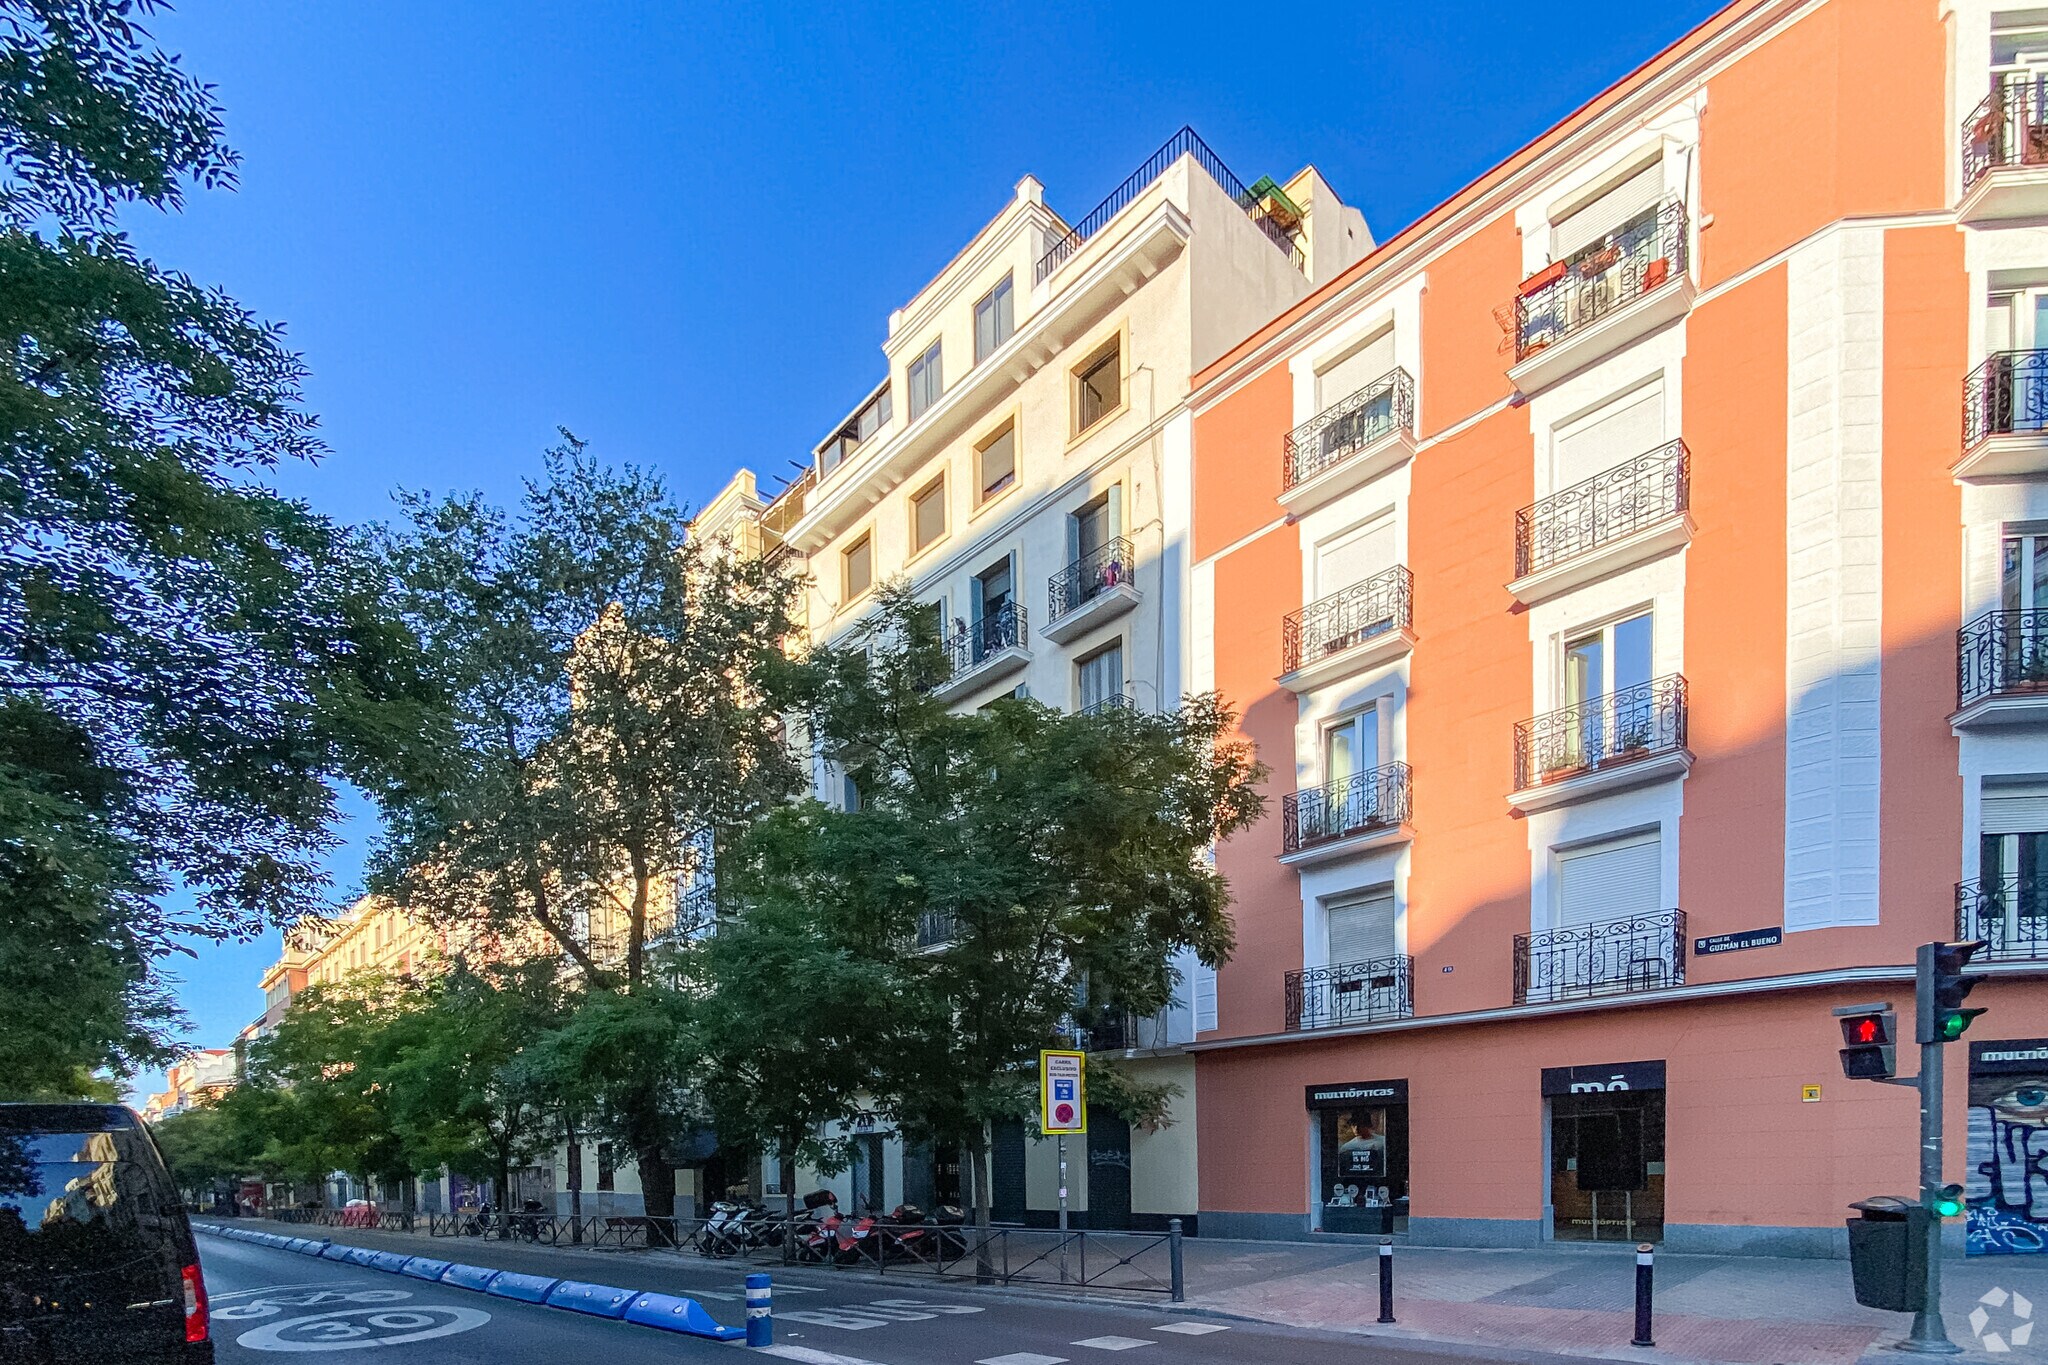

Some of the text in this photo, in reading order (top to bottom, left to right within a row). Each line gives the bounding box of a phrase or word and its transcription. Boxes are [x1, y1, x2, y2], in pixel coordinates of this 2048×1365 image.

[1709, 936, 1778, 952] GUZMÁN EL BUENO
[296, 1312, 435, 1339] 30
[771, 1299, 986, 1331] BUS
